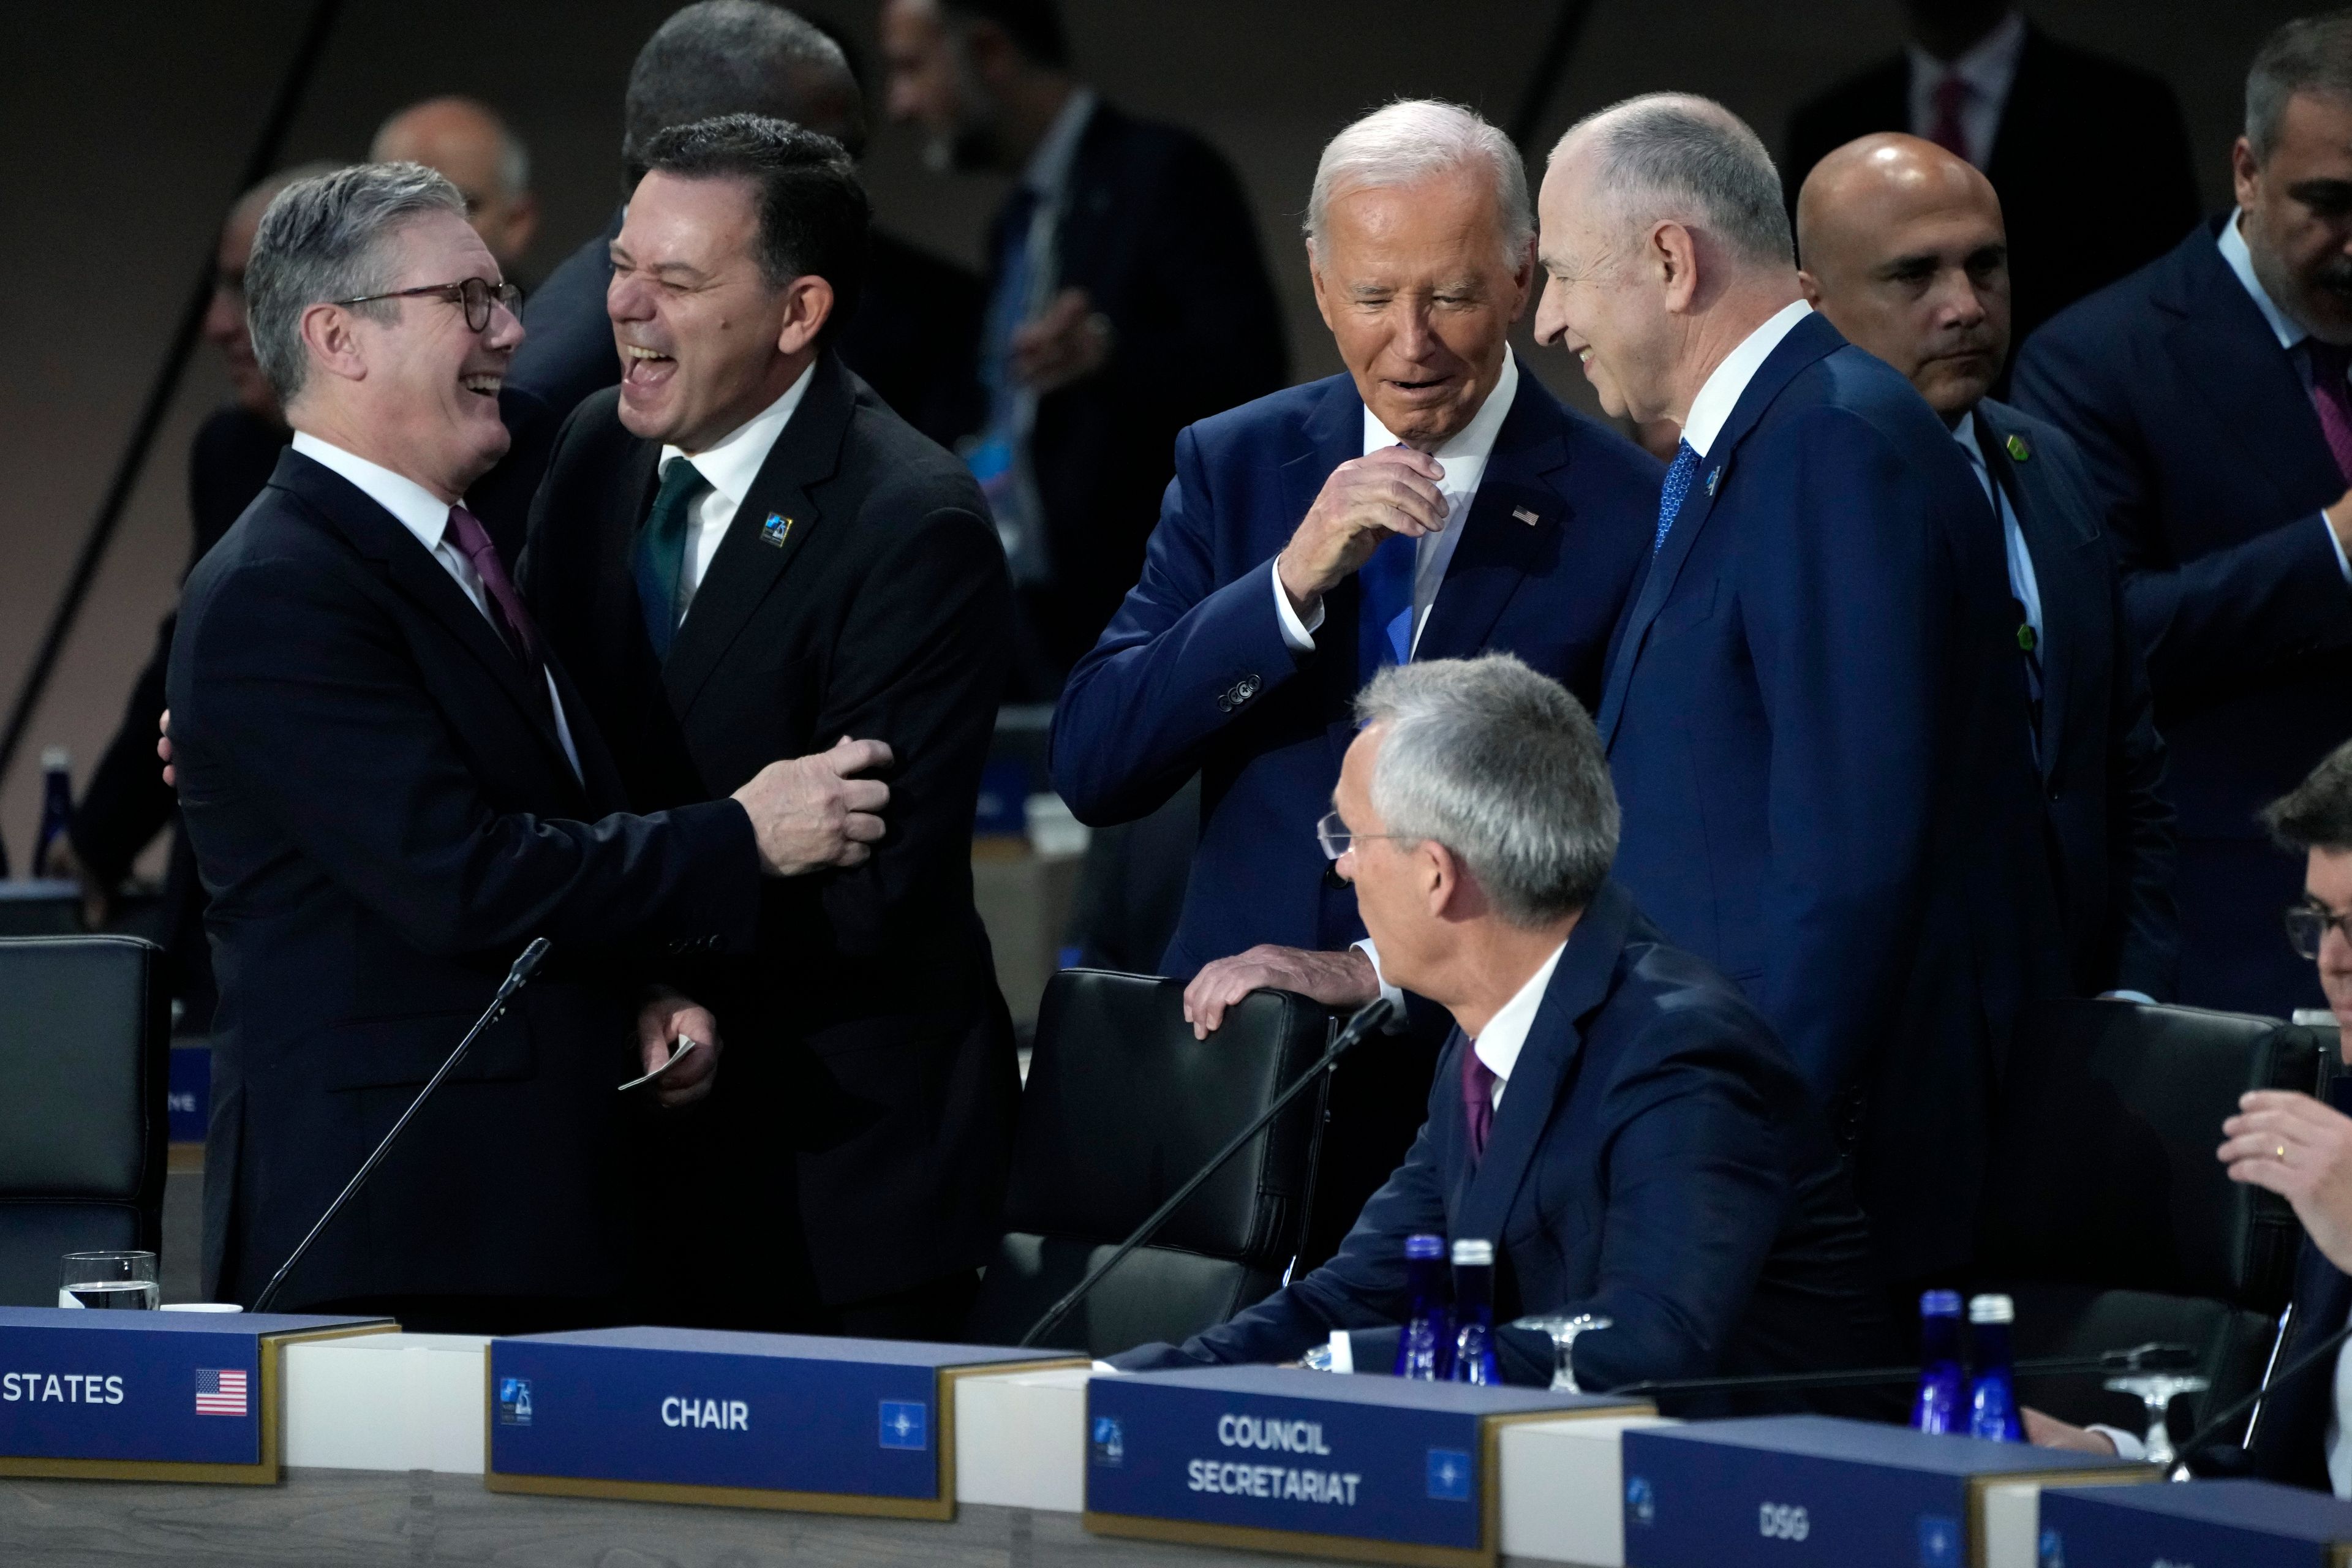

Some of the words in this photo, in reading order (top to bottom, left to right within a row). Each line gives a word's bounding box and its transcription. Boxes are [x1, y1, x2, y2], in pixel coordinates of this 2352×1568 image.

[3, 1373, 123, 1404] STATES
[661, 1396, 748, 1431] CHAIR
[1218, 1414, 1330, 1455] COUNCIL
[1188, 1459, 1361, 1506] SECRETARIAT
[1760, 1502, 1809, 1541] DSG
